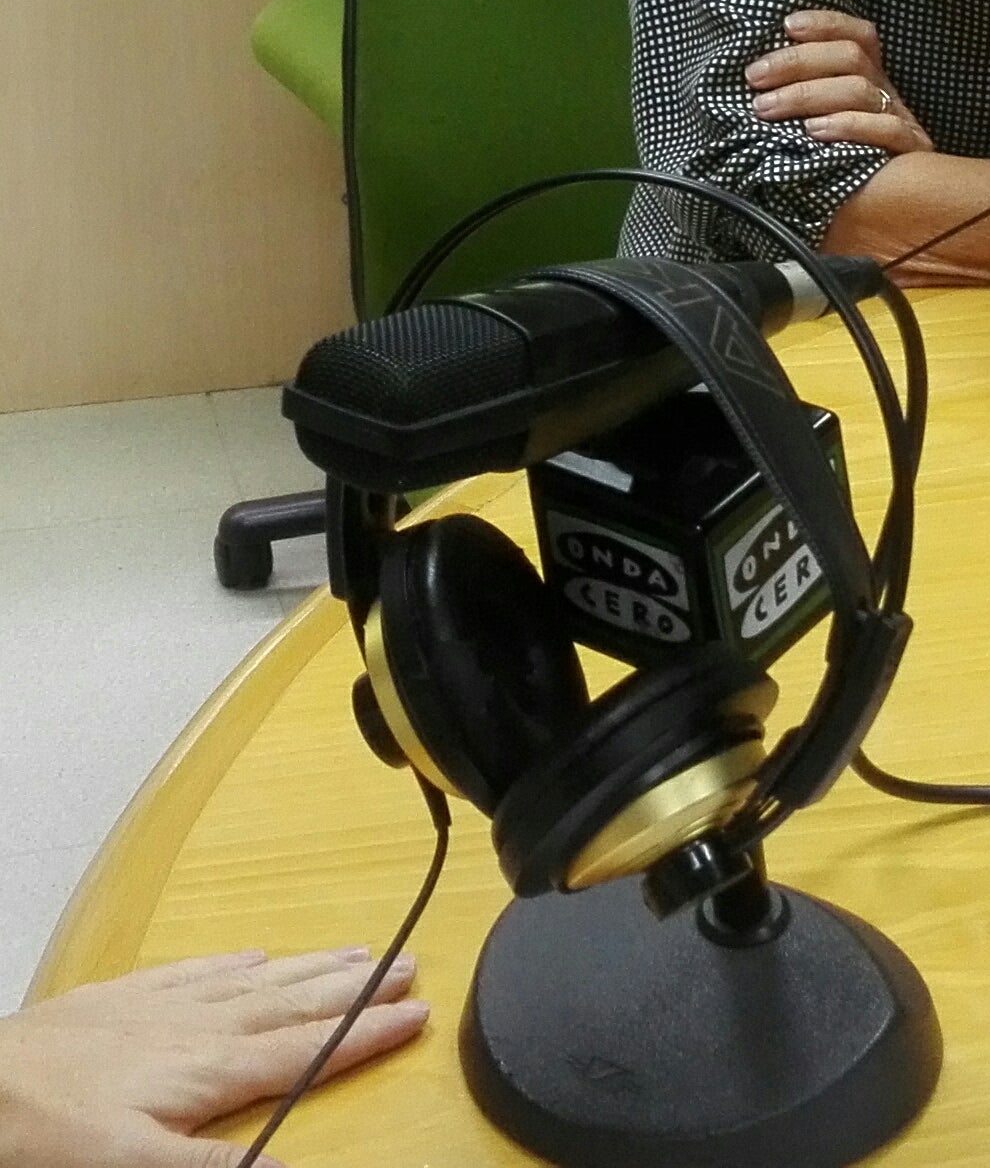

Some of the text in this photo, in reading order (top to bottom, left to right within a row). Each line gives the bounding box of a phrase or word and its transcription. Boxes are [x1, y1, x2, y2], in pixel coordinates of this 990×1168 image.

[566, 536, 667, 591] ONDA
[755, 554, 811, 622] CER
[579, 583, 673, 634] CERO
